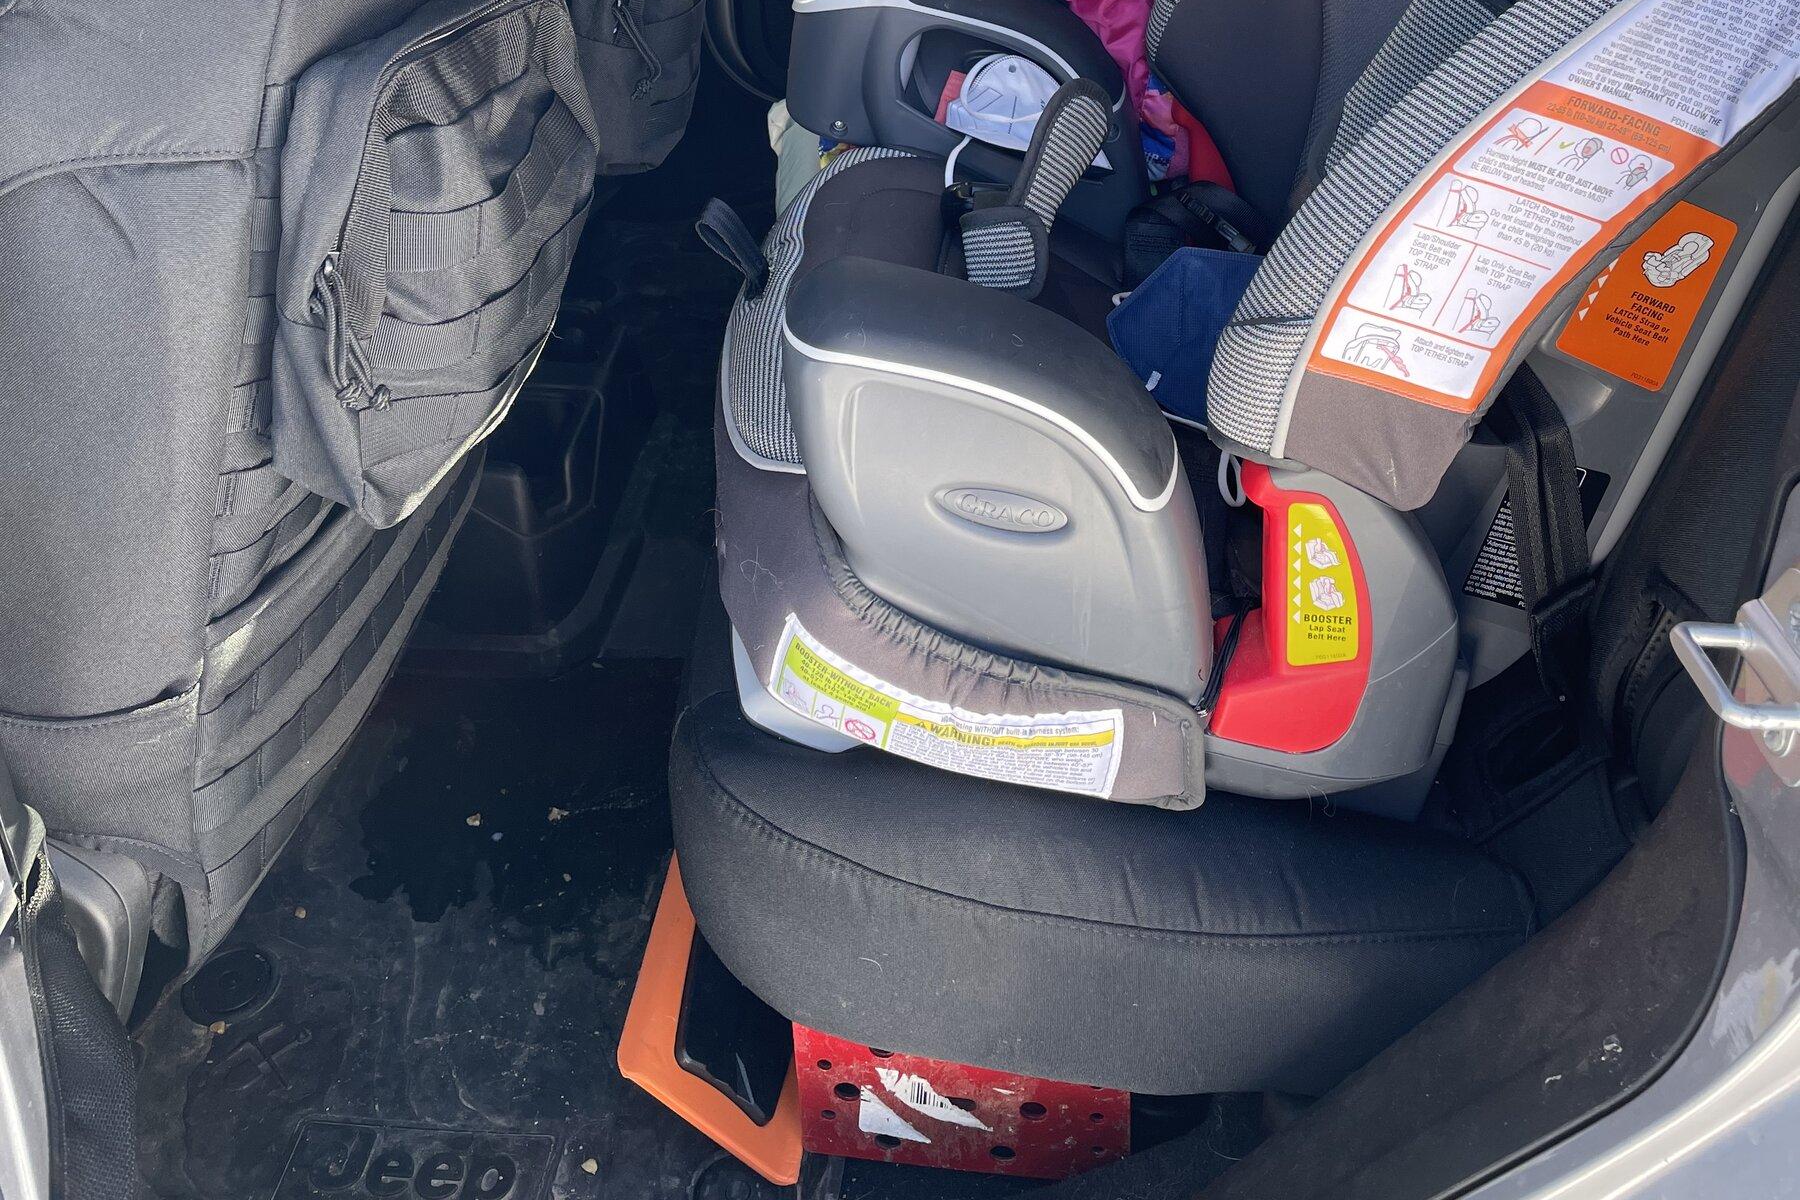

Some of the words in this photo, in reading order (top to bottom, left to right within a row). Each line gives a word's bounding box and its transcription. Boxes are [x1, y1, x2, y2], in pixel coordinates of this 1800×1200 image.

[1695, 3, 1726, 19] provided
[1728, 14, 1742, 24] with
[1744, 20, 1757, 29] this
[1759, 6, 1773, 15] and
[1776, 2, 1789, 13] kg)
[1634, 20, 1652, 31] child
[1651, 25, 1678, 40] restraint
[1677, 35, 1714, 55] anchorage
[1714, 49, 1741, 64] system
[1650, 15, 1672, 28] Secure
[1672, 23, 1686, 33] this
[1687, 28, 1704, 39] child
[1704, 34, 1733, 50] restraint
[1734, 46, 1750, 57] with
[1714, 29, 1727, 38] this
[1728, 34, 1746, 45] child
[1656, 47, 1665, 55] on
[1666, 50, 1680, 60] this
[1679, 55, 1696, 66] child
[1696, 62, 1726, 78] restraint
[1568, 73, 1601, 90] OWNER'S
[1601, 85, 1634, 101] MANUAL.
[1634, 58, 1662, 73] Register
[1662, 69, 1679, 81] your
[1678, 73, 1696, 85] child
[1696, 81, 1726, 97] restraint
[1567, 96, 1661, 135] FORWARD-FACING
[1622, 82, 1663, 102] IMPORTANT
[1664, 97, 1675, 106] TO
[1675, 102, 1708, 120] FOLLOW
[1708, 116, 1721, 126] THE
[1470, 162, 1480, 170] BE
[1480, 164, 1502, 176] BELOW
[1501, 172, 1512, 181] top
[1512, 174, 1519, 182] of
[1478, 155, 1498, 166] child's
[1498, 161, 1525, 174] shoulders
[1525, 170, 1536, 178] and
[1536, 174, 1546, 182] top
[1554, 180, 1574, 191] child's
[1573, 188, 1587, 196] ears
[1586, 192, 1606, 203] MUST
[1527, 161, 1547, 172] MUST
[1565, 174, 1575, 182] OR
[1575, 177, 1592, 188] JUST
[1591, 184, 1614, 197] ABOVE
[1507, 204, 1522, 214] TOP
[1523, 210, 1551, 224] TETHER
[1550, 219, 1574, 233] STRAP
[1516, 197, 1539, 210] LATCH
[1540, 206, 1559, 218] Strap
[1559, 213, 1574, 222] with
[1490, 209, 1500, 217] Do
[1501, 213, 1513, 221] not
[1513, 217, 1533, 227] install
[1534, 224, 1543, 233] by
[1543, 228, 1556, 236] this
[1556, 232, 1582, 245] method
[1490, 219, 1500, 227] for
[1507, 225, 1523, 235] child
[1524, 232, 1553, 246] weighing
[1554, 242, 1571, 251] more
[1412, 239, 1428, 249] Seat
[1428, 244, 1441, 253] Belt
[1442, 248, 1457, 258] with
[1497, 231, 1512, 241] than
[1530, 243, 1543, 253] (20
[1408, 247, 1423, 256] TOP
[1423, 252, 1450, 266] TETHER
[1414, 258, 1438, 271] STRAP
[1476, 255, 1490, 265] Lap
[1490, 260, 1506, 270] Only
[1506, 265, 1522, 276] Seat
[1522, 271, 1536, 280] Belt
[1474, 265, 1489, 273] with
[1490, 269, 1504, 279] TOP
[1505, 275, 1531, 288] TETHER
[1487, 278, 1510, 291] STRAP
[1630, 291, 1675, 312] FORWARD
[1630, 303, 1664, 320] FACING
[1605, 314, 1632, 328] Vehicle
[1633, 325, 1651, 335] Seat
[1652, 332, 1668, 342] Belt
[1613, 307, 1638, 320] LATCH
[1638, 317, 1660, 330] Strap
[1613, 327, 1630, 338] Path
[1631, 334, 1650, 345] Here
[1410, 344, 1423, 353] TOP
[1423, 348, 1447, 361] TETHER
[1433, 343, 1445, 351] and
[1444, 346, 1464, 358] tighten
[1464, 352, 1474, 360] the
[953, 492, 1056, 529] GRACO
[1304, 613, 1351, 624] BOOSTER
[795, 643, 866, 696] BOOSTER-WITHOUT
[868, 693, 892, 707] BACK
[928, 724, 995, 746] WARNING!
[974, 723, 1004, 735] WITHOUT
[308, 1125, 516, 1200] Jeep
